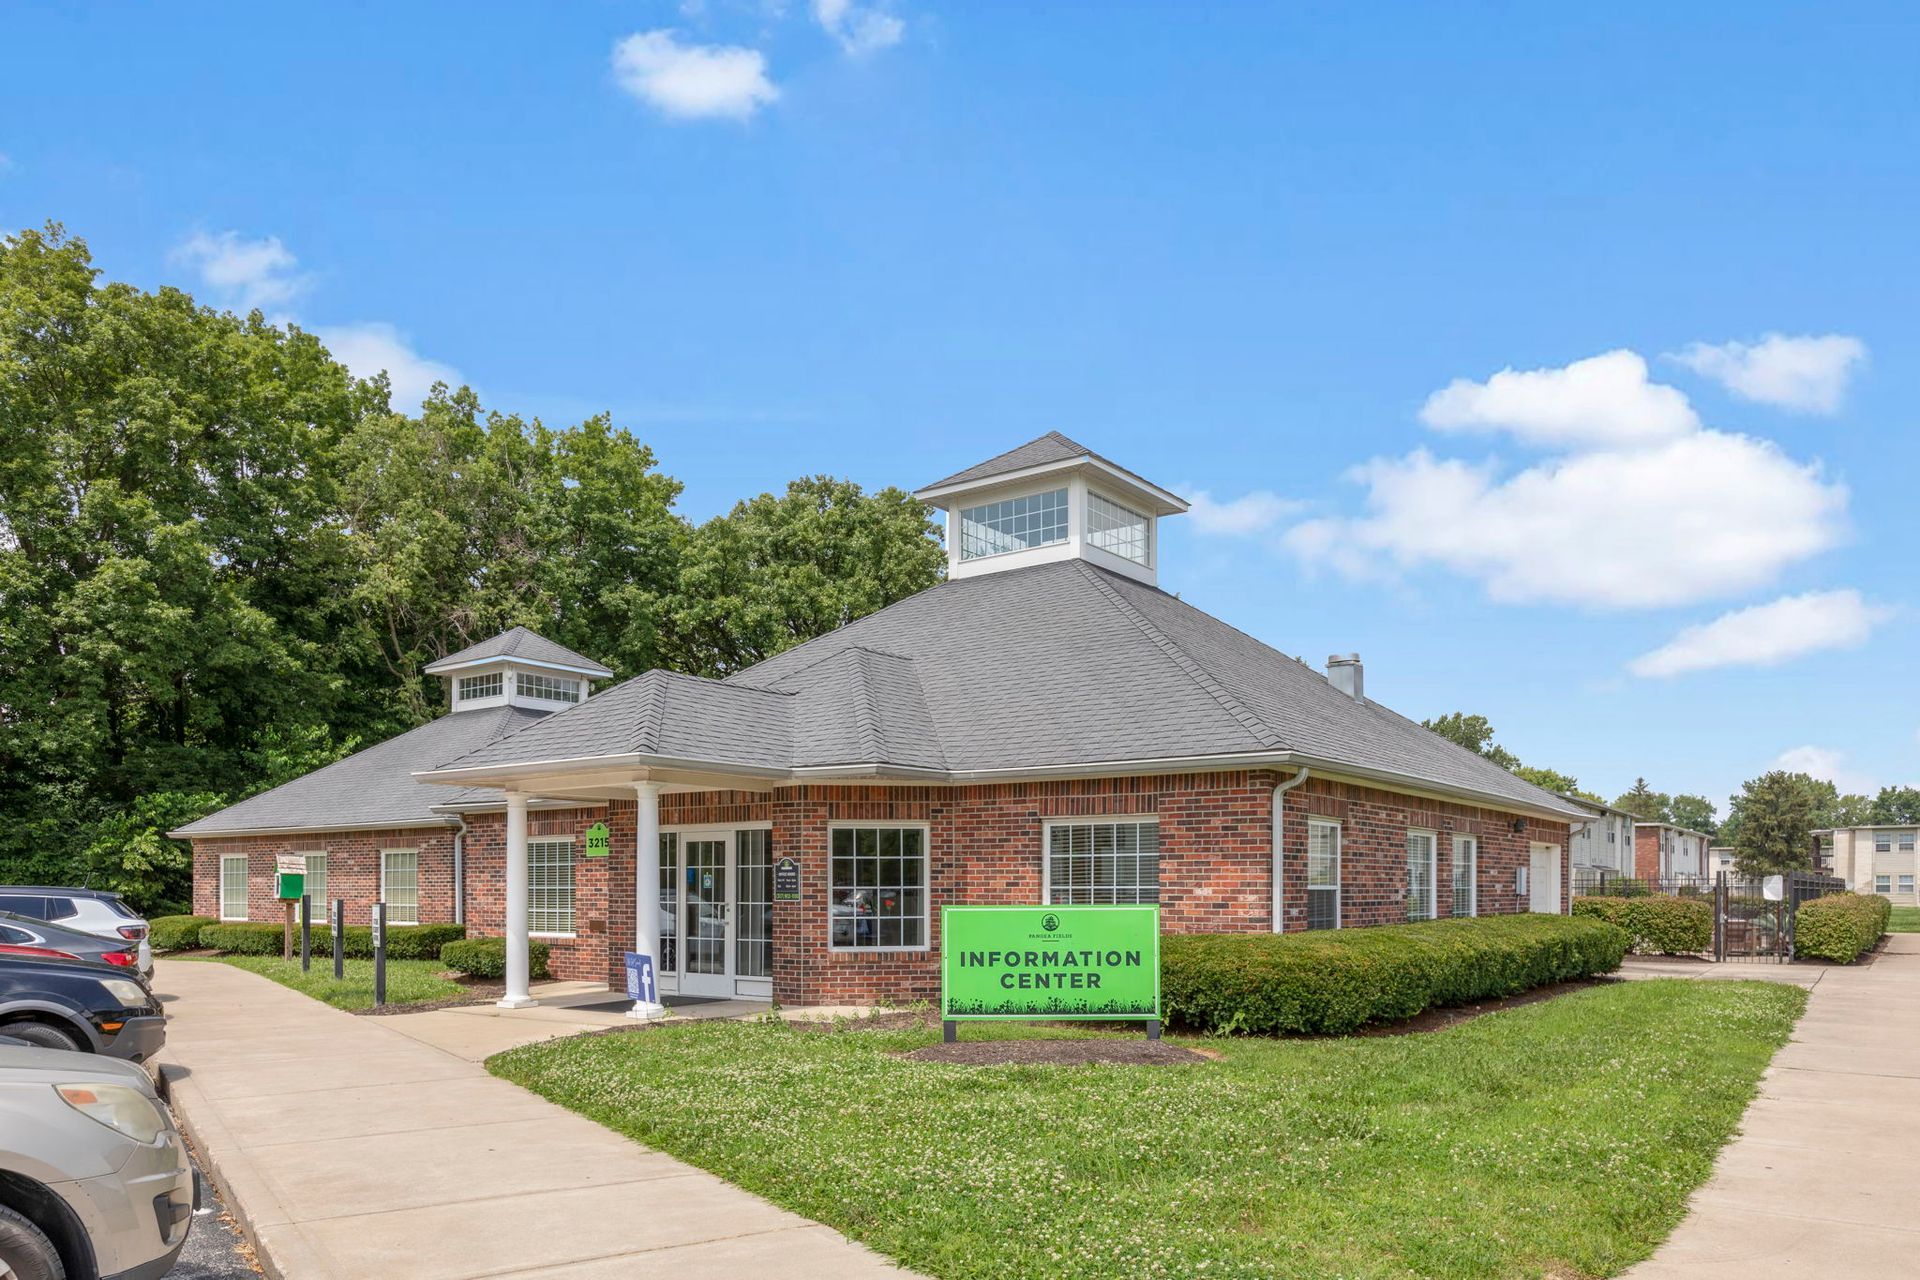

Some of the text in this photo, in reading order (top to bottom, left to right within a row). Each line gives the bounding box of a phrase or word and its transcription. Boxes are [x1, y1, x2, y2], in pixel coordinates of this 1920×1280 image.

[588, 837, 609, 848] 3215
[960, 950, 1141, 967] INFORMATION
[1000, 973, 1101, 989] CENTER
